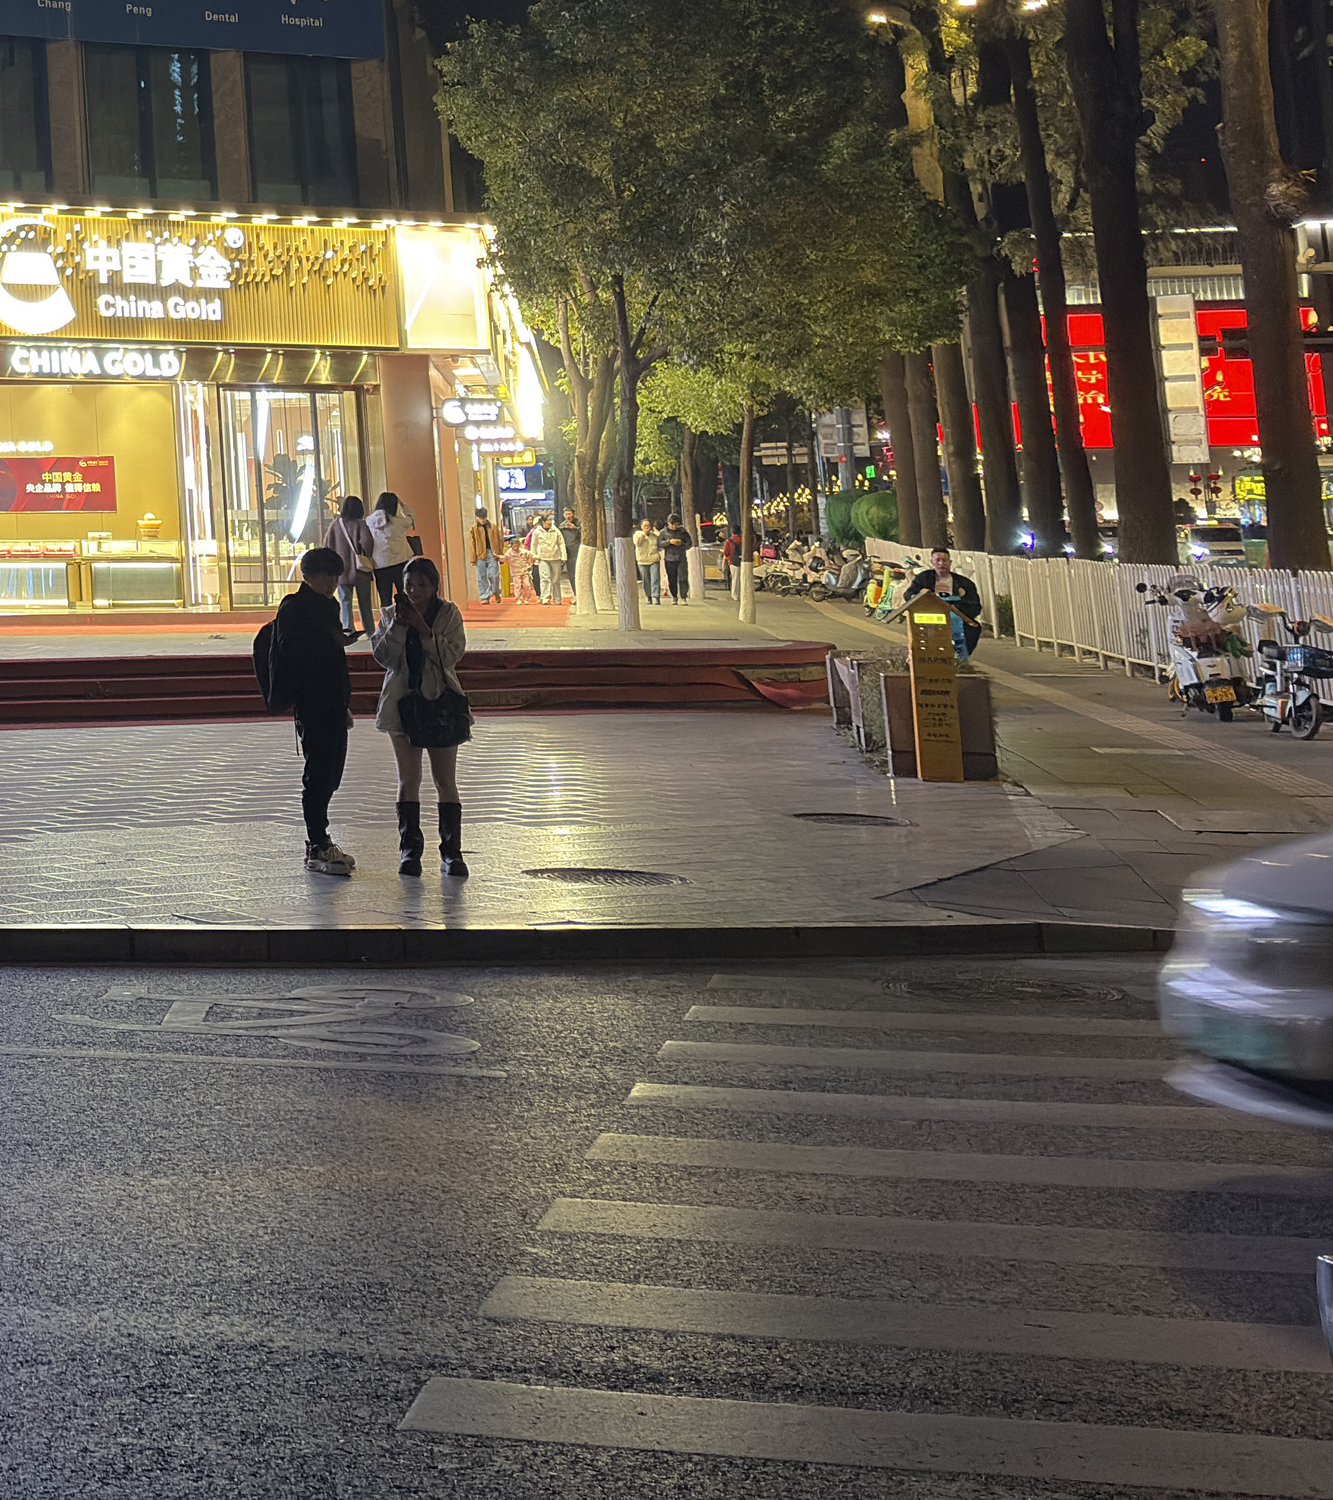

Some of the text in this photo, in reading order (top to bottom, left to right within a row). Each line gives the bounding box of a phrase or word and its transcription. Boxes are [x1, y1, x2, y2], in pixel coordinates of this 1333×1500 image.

[125, 3, 153, 18] Peng
[204, 11, 239, 24] Dental
[280, 14, 324, 28] Hospital
[85, 239, 232, 289] 中国黄金
[97, 293, 223, 321] China Gold
[10, 346, 181, 377] CHINA GOLD
[41, 471, 84, 483] 中国黄金
